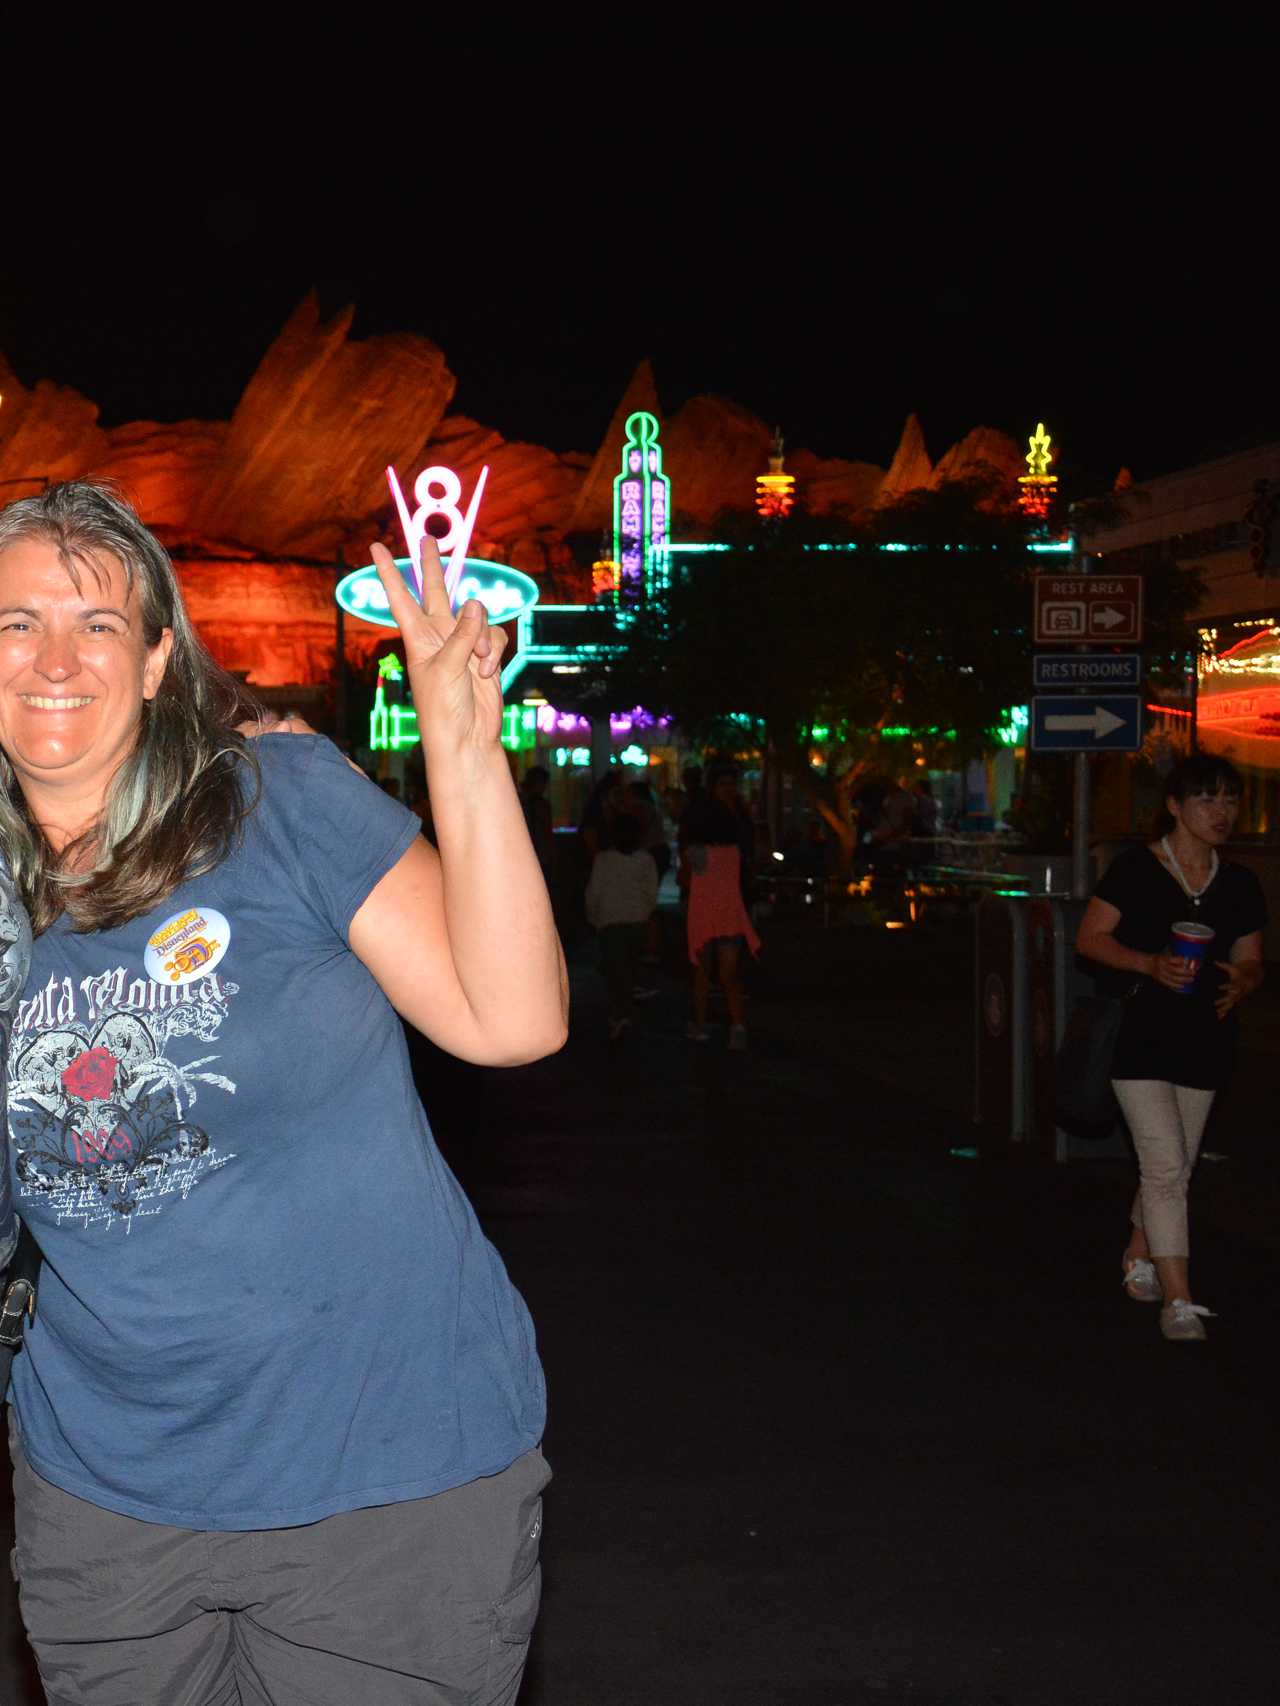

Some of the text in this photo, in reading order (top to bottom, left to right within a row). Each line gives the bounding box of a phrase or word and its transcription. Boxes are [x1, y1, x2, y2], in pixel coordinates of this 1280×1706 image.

[1051, 582, 1124, 593] REST AREA
[1041, 663, 1131, 677] RESTROOMS
[152, 916, 208, 957] Disneyland
